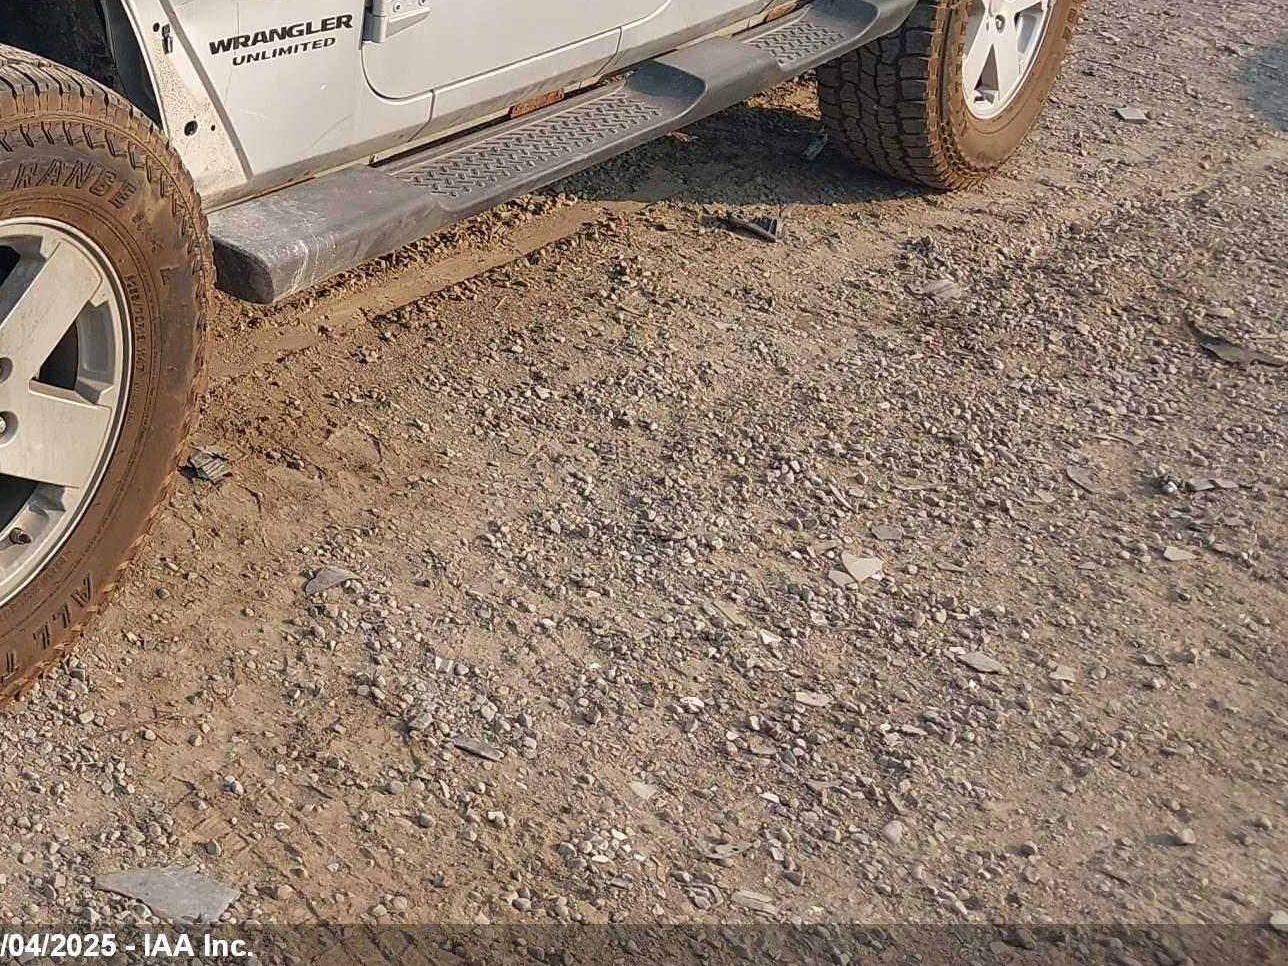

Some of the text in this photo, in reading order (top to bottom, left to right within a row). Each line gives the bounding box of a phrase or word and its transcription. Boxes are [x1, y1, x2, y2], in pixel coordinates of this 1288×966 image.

[208, 13, 353, 55] WRANGLER
[232, 37, 336, 66] UNLIMITED
[32, 570, 94, 651] ALL
